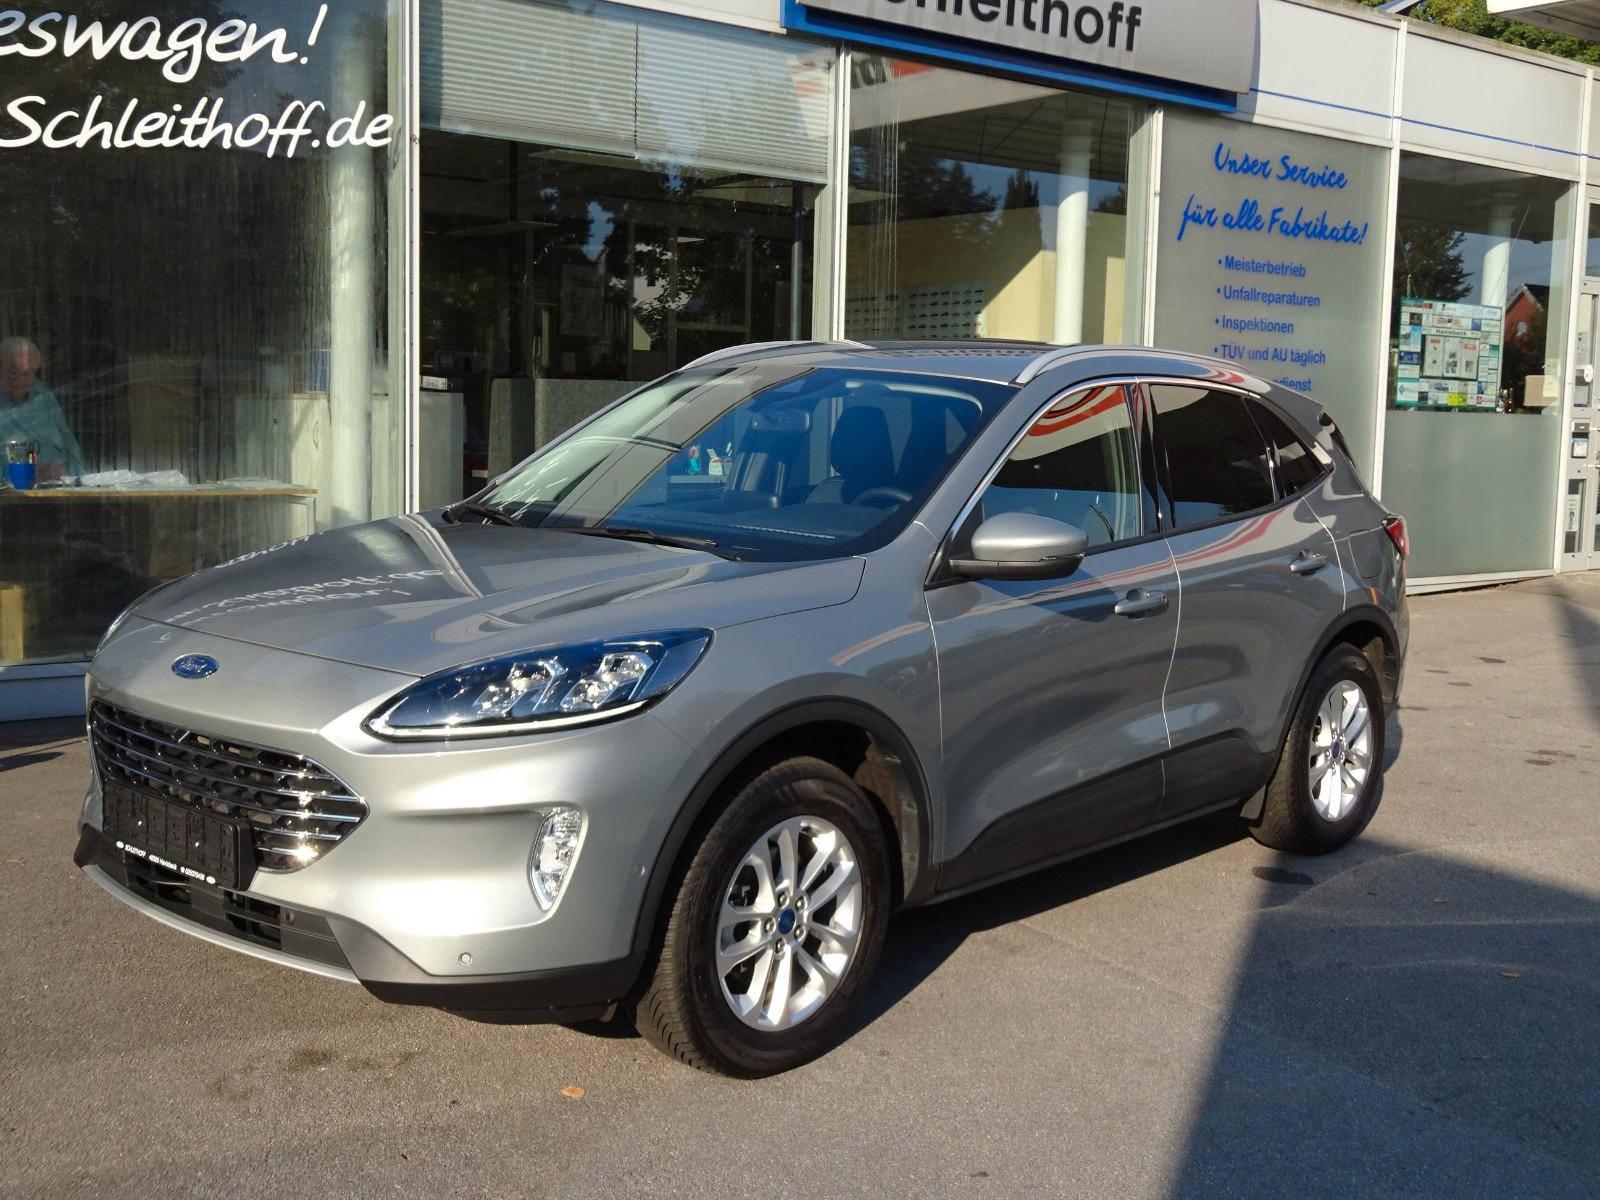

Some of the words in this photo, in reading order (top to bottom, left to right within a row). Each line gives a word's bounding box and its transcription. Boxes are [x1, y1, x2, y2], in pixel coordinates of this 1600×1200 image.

[886, 0, 1142, 52] eithoff
[0, 95, 394, 158] Schleithoff.de
[1213, 142, 1272, 180] Unser
[1275, 154, 1348, 190] Service
[1176, 194, 1218, 241] für
[1222, 198, 1265, 232] alle
[1266, 206, 1369, 245] Fabrikate!
[1223, 255, 1307, 278] Meisterbetrieb
[1222, 285, 1321, 307] Unfallreparaturen
[1221, 315, 1295, 334] Inspektionen
[1220, 342, 1245, 359] TÜV
[1248, 346, 1269, 362] und
[1271, 348, 1288, 363] AU
[1289, 349, 1327, 367] täglich
[1272, 376, 1313, 393] dienst
